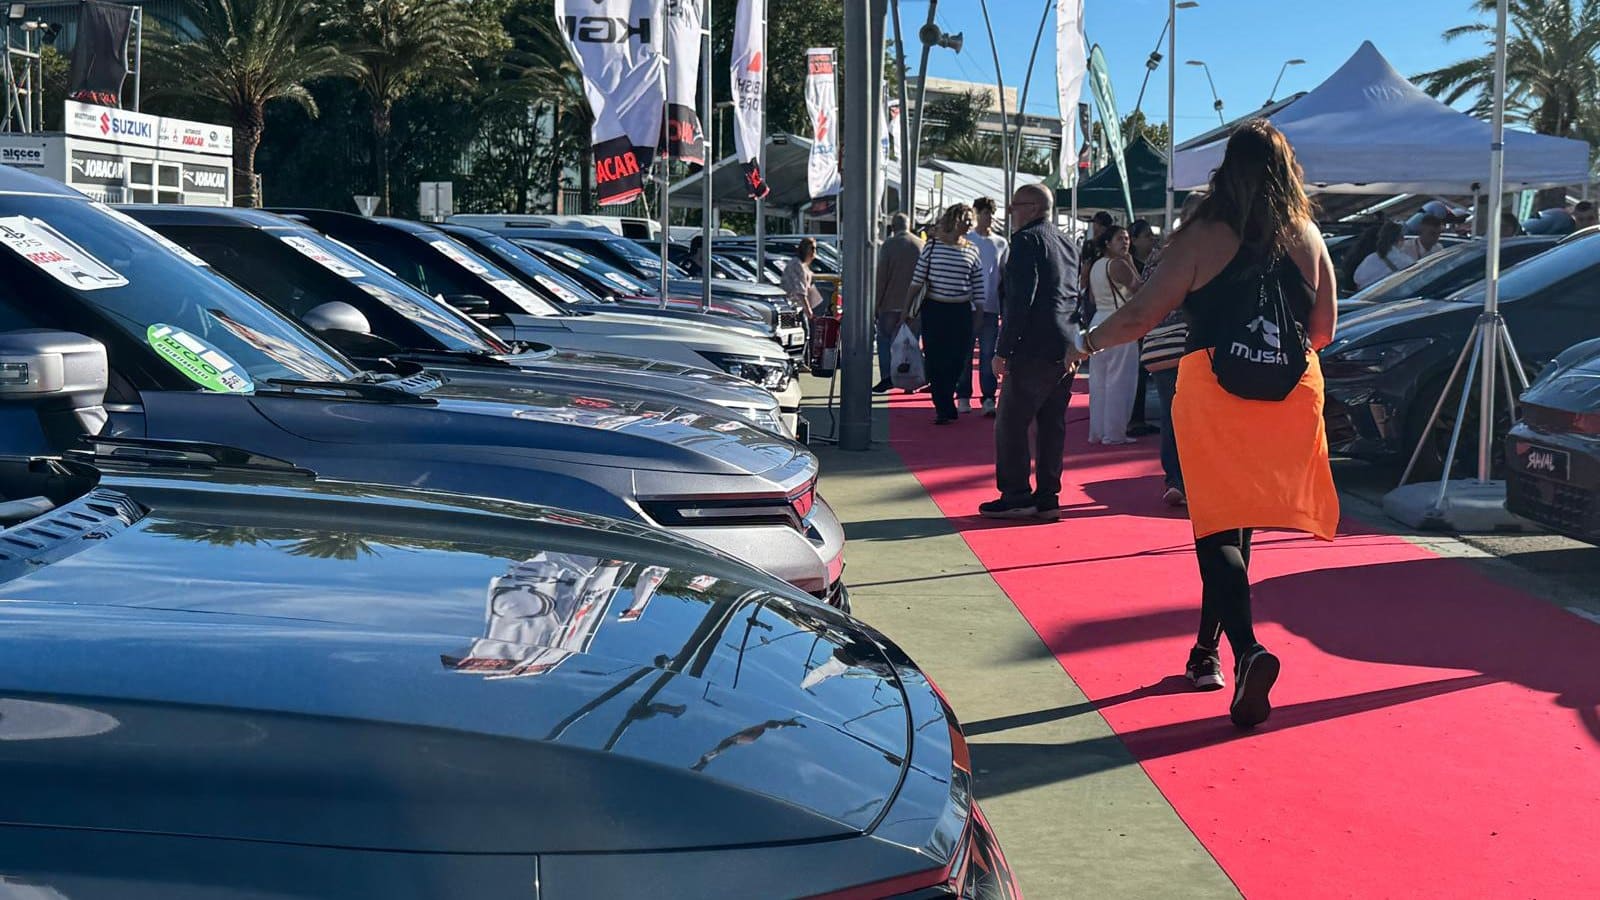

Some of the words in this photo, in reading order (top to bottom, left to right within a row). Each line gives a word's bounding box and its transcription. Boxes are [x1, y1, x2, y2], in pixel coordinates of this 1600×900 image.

[112, 118, 152, 138] SUZUKI
[84, 159, 124, 178] JOBACAR
[194, 171, 225, 188] JOBACAR
